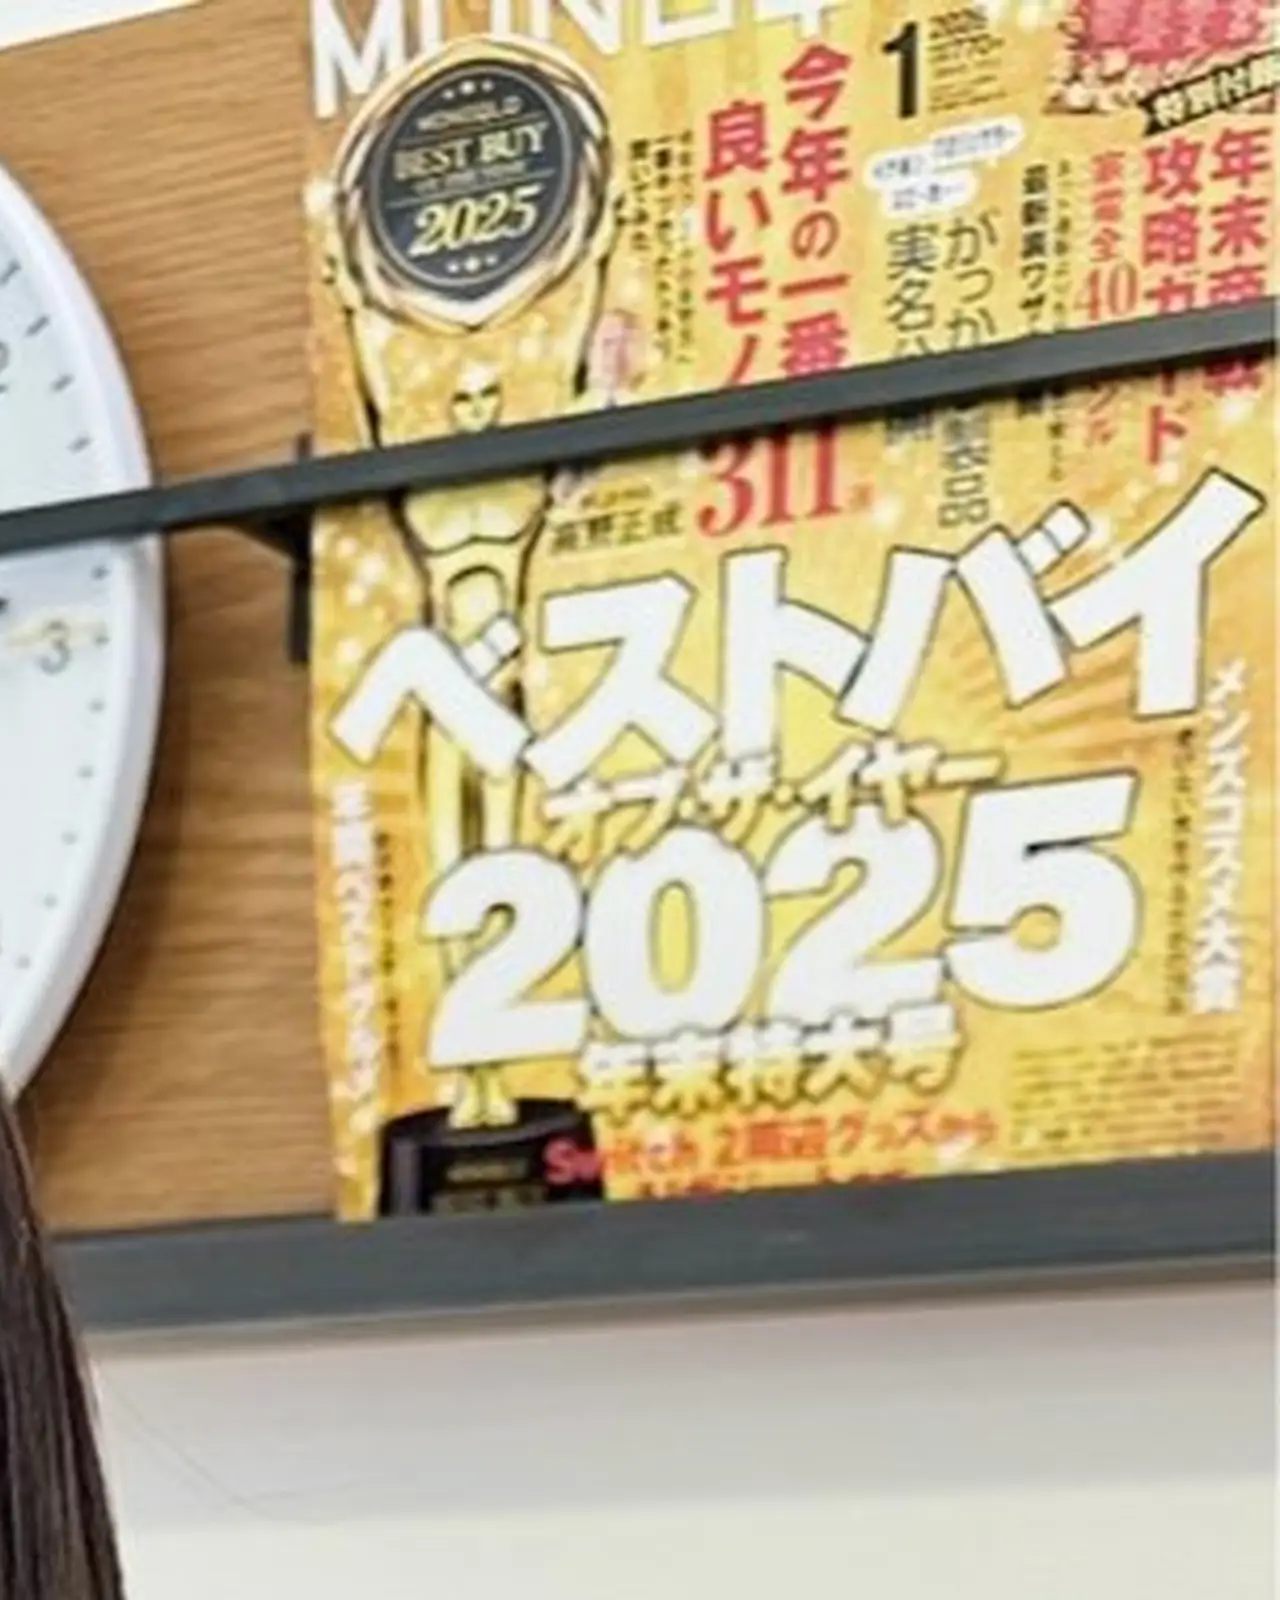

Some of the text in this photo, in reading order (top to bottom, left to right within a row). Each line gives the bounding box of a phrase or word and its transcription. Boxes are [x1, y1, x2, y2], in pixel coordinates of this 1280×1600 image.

[780, 42, 853, 378] 今年の一番
[881, 20, 918, 119] 1
[408, 183, 544, 258] 2025
[703, 100, 771, 388] 良いモノ
[38, 622, 73, 675] 3
[328, 464, 1268, 788] ベストバイ
[422, 769, 1144, 1068] 2025
